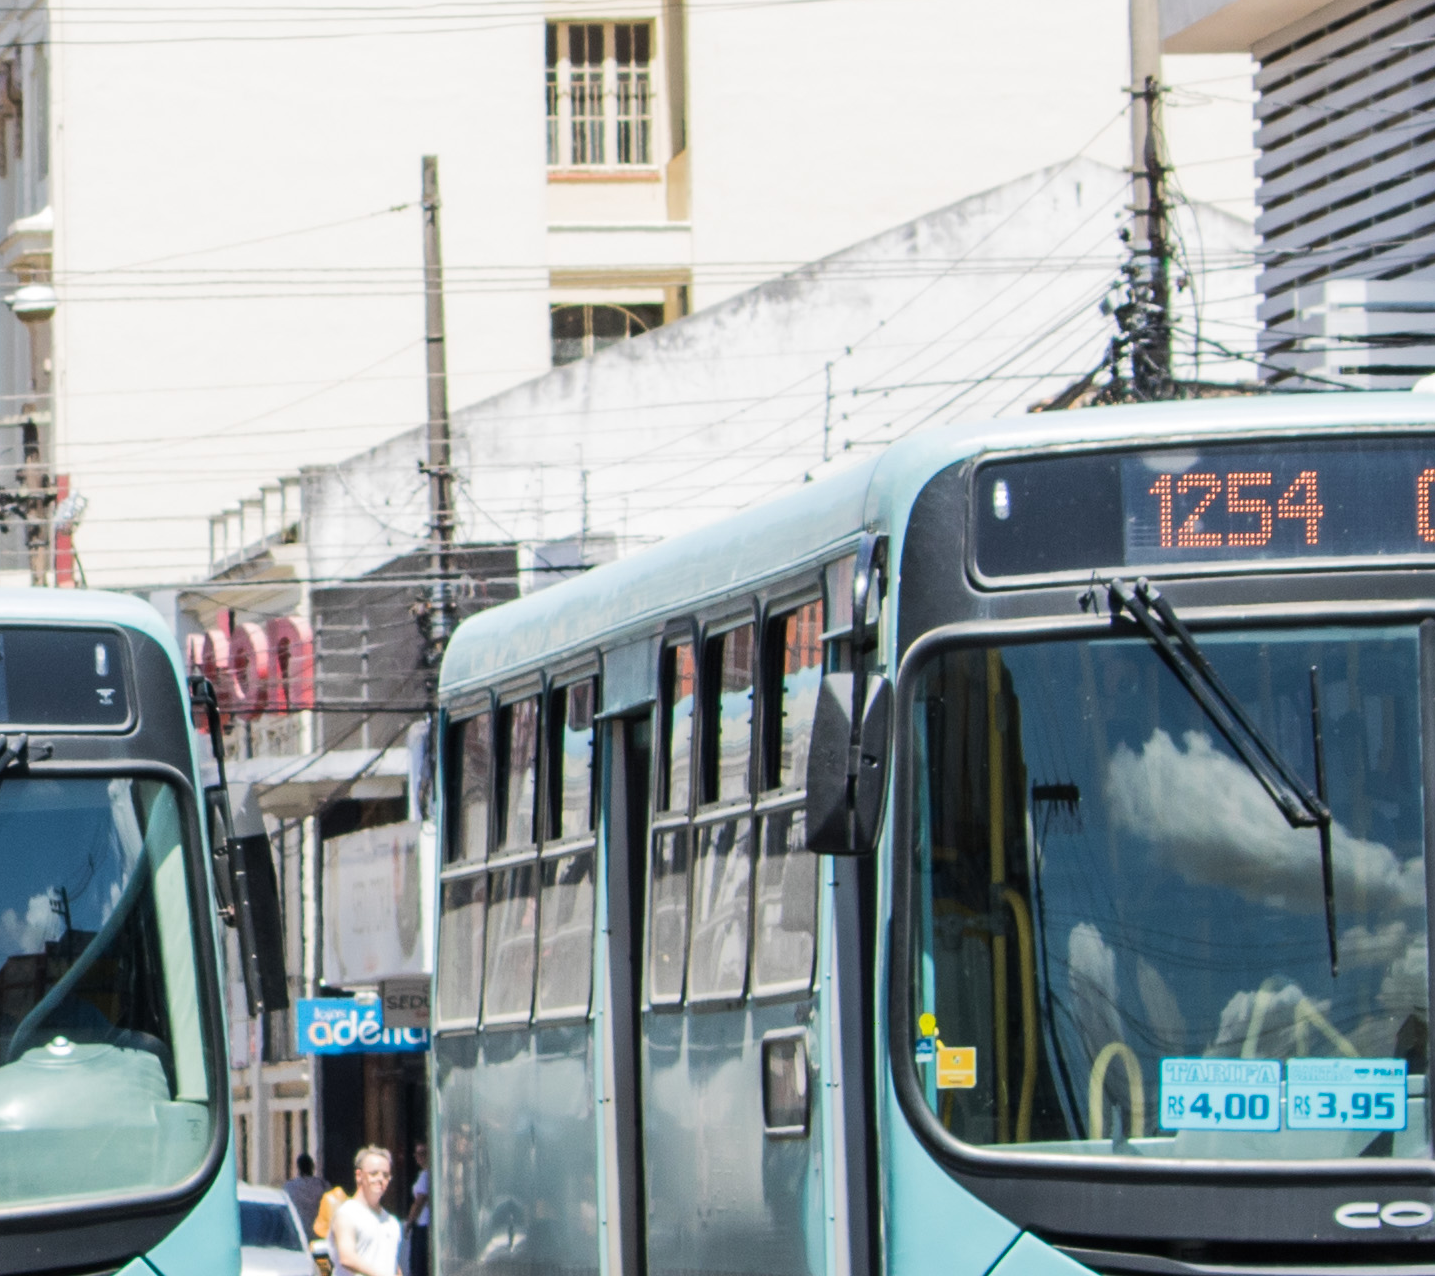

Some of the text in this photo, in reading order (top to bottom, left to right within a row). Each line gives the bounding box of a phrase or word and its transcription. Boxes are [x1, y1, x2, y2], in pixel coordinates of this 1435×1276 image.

[1149, 469, 1325, 550] 1254
[1165, 1063, 1277, 1084] TARIFA
[1168, 1093, 1270, 1123] R$ 4,00
[1294, 1092, 1395, 1123] R$ 3,95
